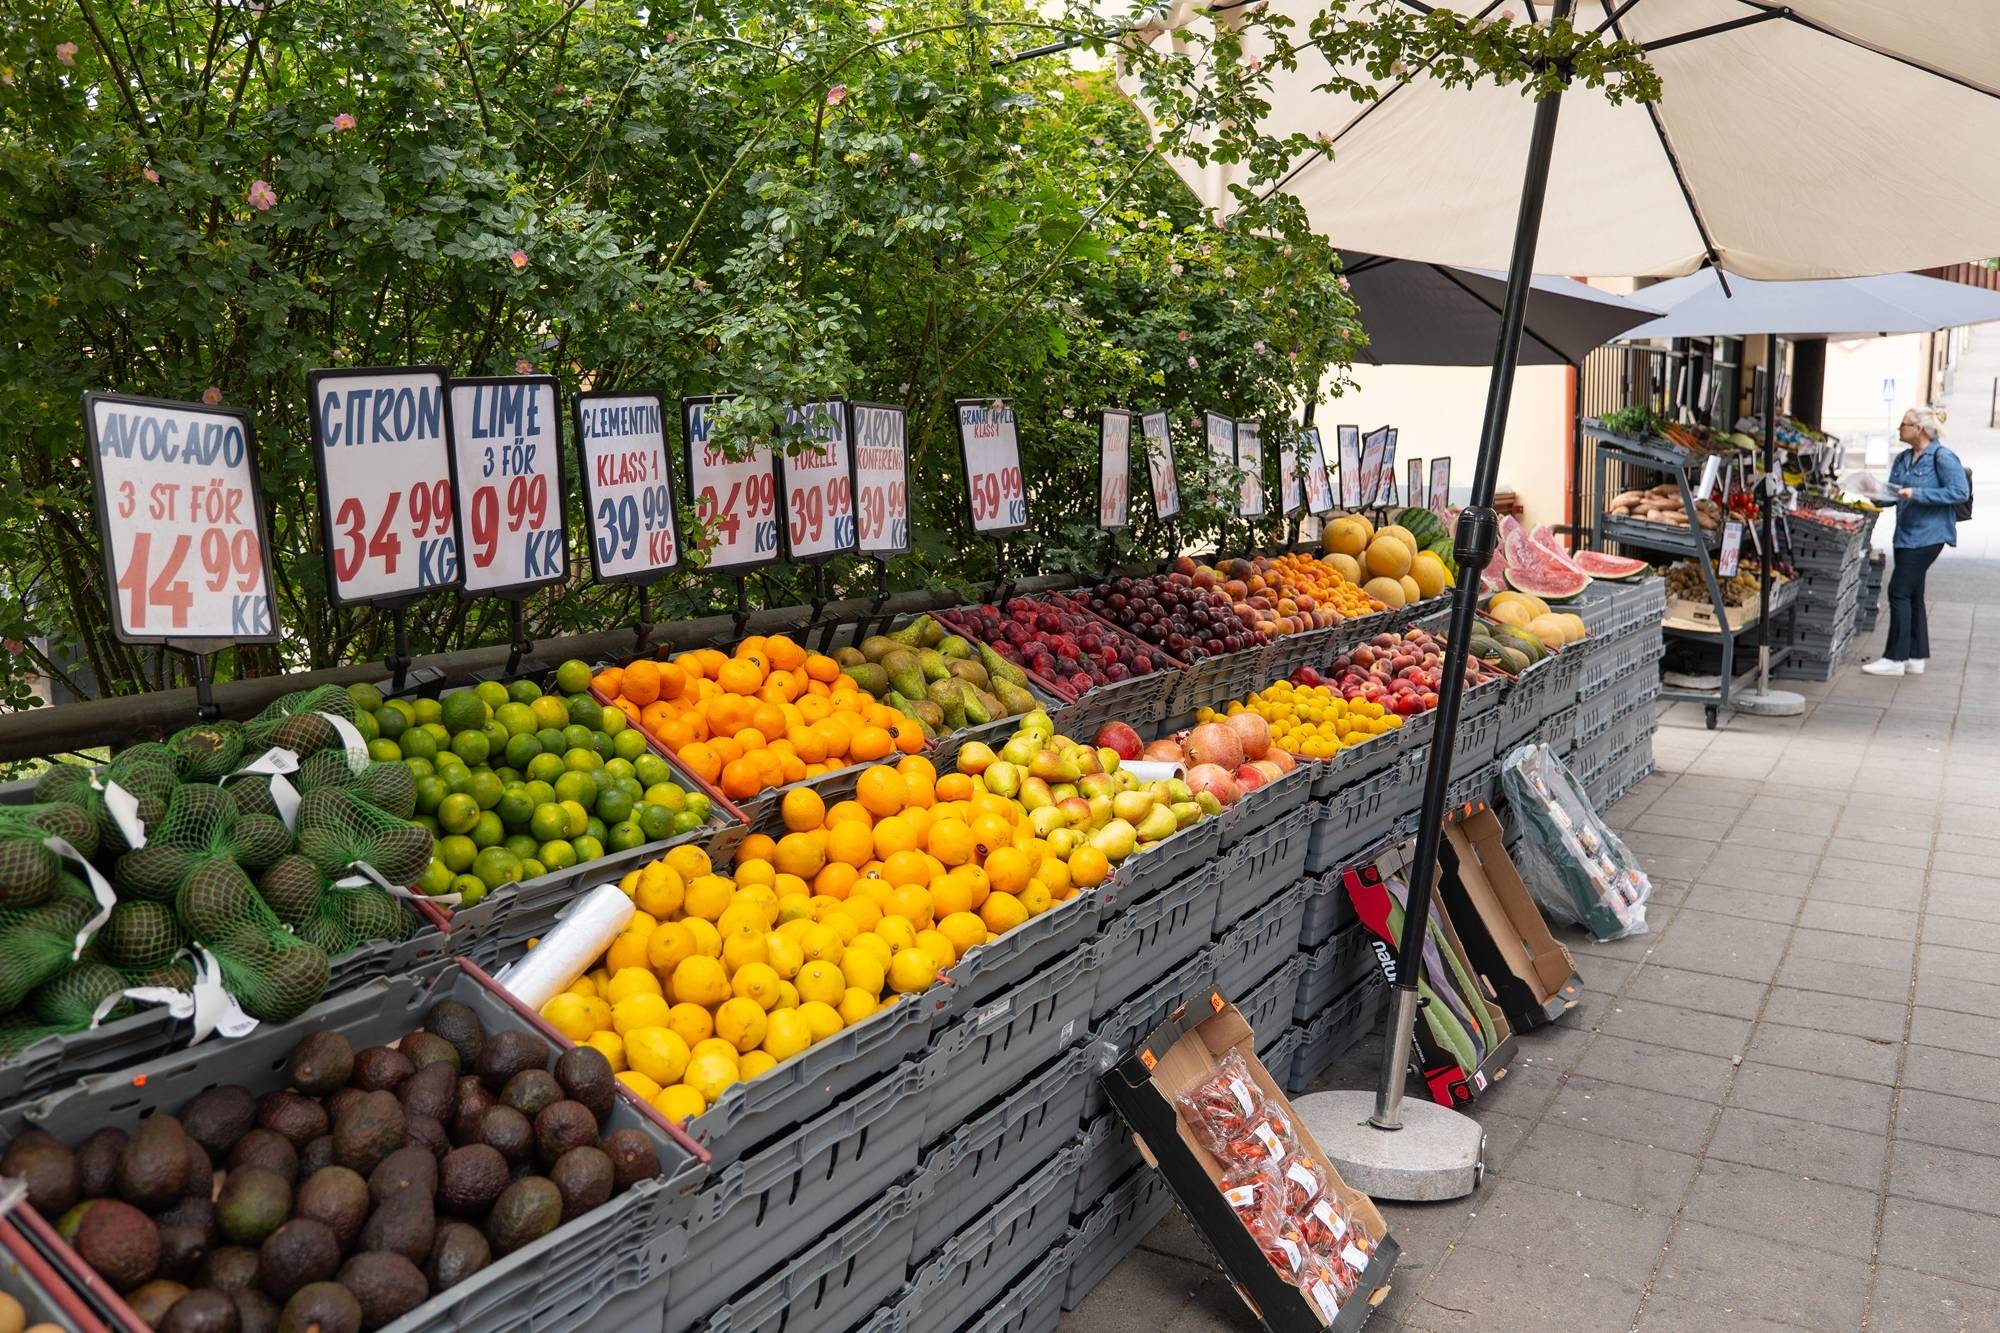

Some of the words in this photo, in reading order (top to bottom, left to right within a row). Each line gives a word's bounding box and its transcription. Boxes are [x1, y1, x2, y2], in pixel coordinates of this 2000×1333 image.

[322, 385, 443, 447] CITRON
[471, 384, 541, 439] LIME
[582, 405, 660, 439] CLEMENTIN
[100, 413, 244, 468] AVOCADO
[974, 424, 995, 438] KLASS
[484, 446, 495, 477] 3
[502, 437, 536, 476] FÖR
[597, 451, 647, 487] KLASS
[651, 450, 659, 481] 1
[118, 480, 136, 519] 3
[150, 483, 181, 521] ST
[191, 478, 243, 525] FÖR
[1010, 500, 1026, 524] KG
[648, 529, 673, 566] KG
[755, 520, 776, 553] KG
[835, 515, 854, 548] KG
[892, 518, 907, 549] KG
[418, 537, 457, 590] KG
[524, 528, 563, 578] KR
[232, 595, 270, 634] KR
